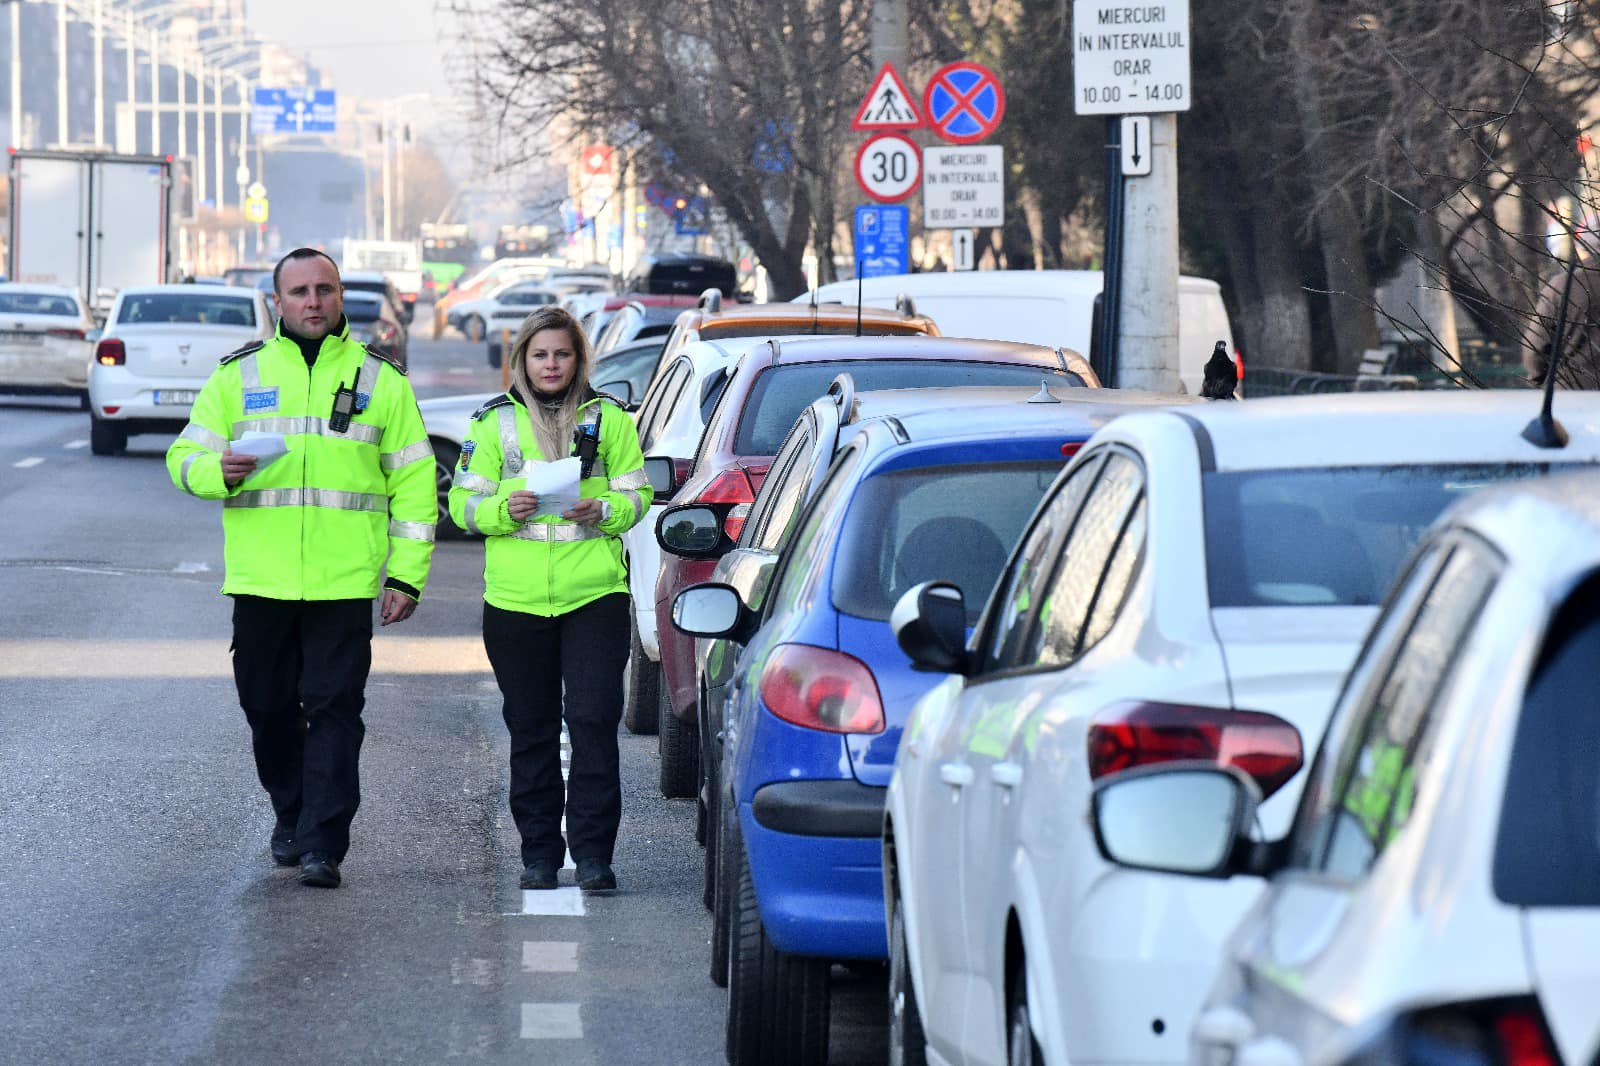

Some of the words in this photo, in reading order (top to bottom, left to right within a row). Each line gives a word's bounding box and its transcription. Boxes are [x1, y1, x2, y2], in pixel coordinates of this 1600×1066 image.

[1098, 6, 1166, 25] MIERCURI
[1098, 32, 1185, 51] INTERVALUL
[1113, 58, 1151, 76] ORAR
[1083, 86, 1121, 104] 10.00
[1145, 83, 1183, 101] 14.00
[872, 151, 907, 183] 30
[940, 154, 987, 166] MIERCURI
[940, 171, 999, 184] INTERVALUL
[951, 189, 977, 202] ORAR
